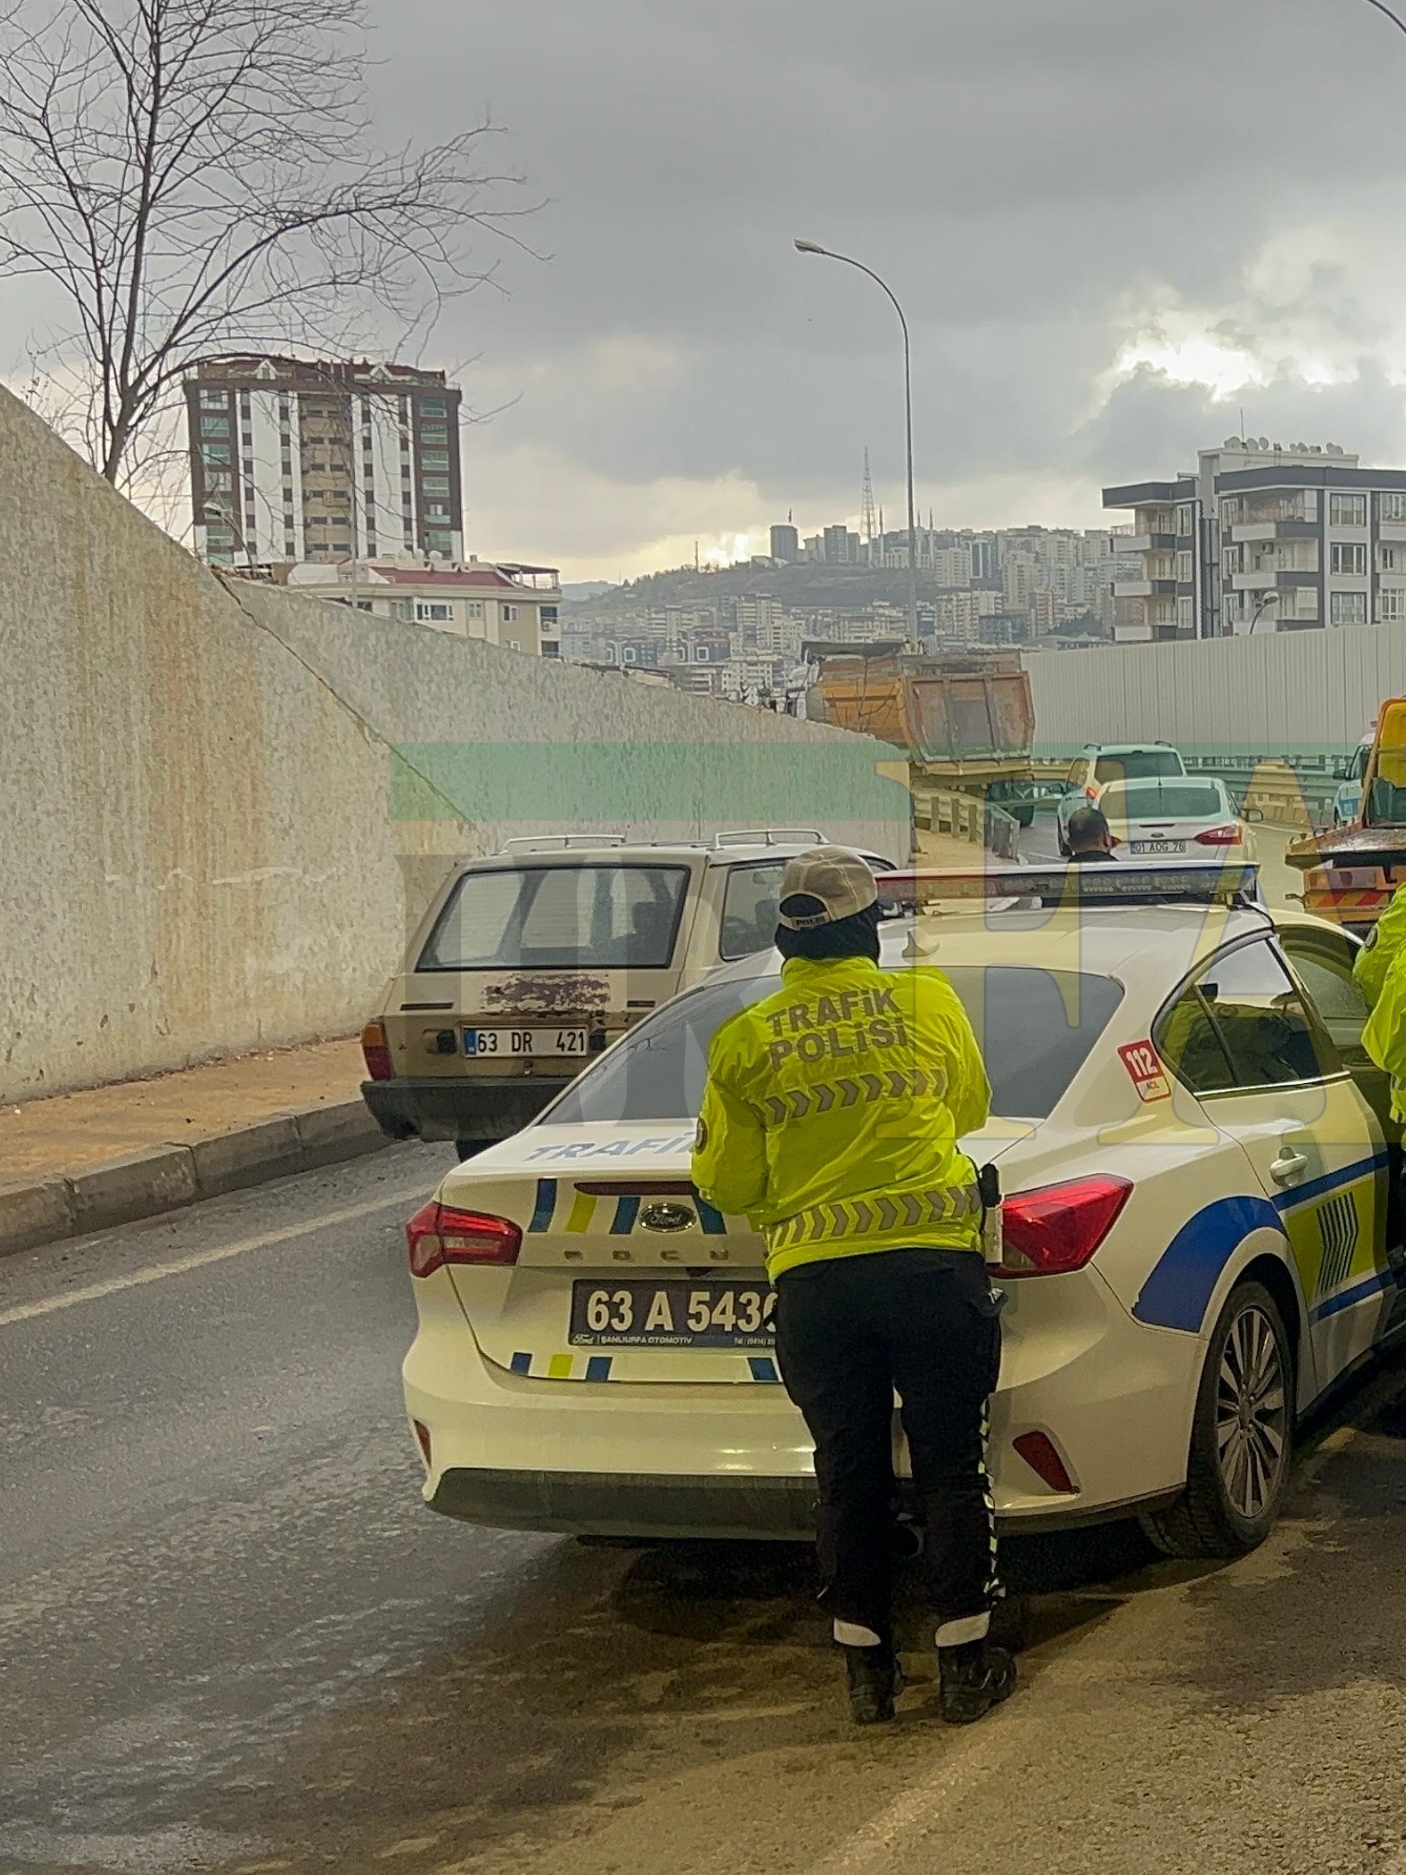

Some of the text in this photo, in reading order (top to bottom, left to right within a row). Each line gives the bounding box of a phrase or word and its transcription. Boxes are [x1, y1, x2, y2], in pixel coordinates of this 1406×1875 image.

[478, 1032, 585, 1052] 63 DR 421
[1125, 1047, 1158, 1077] 112
[523, 1132, 695, 1162] TRAFİ
[587, 1290, 633, 1332] 63
[645, 1290, 674, 1332] A
